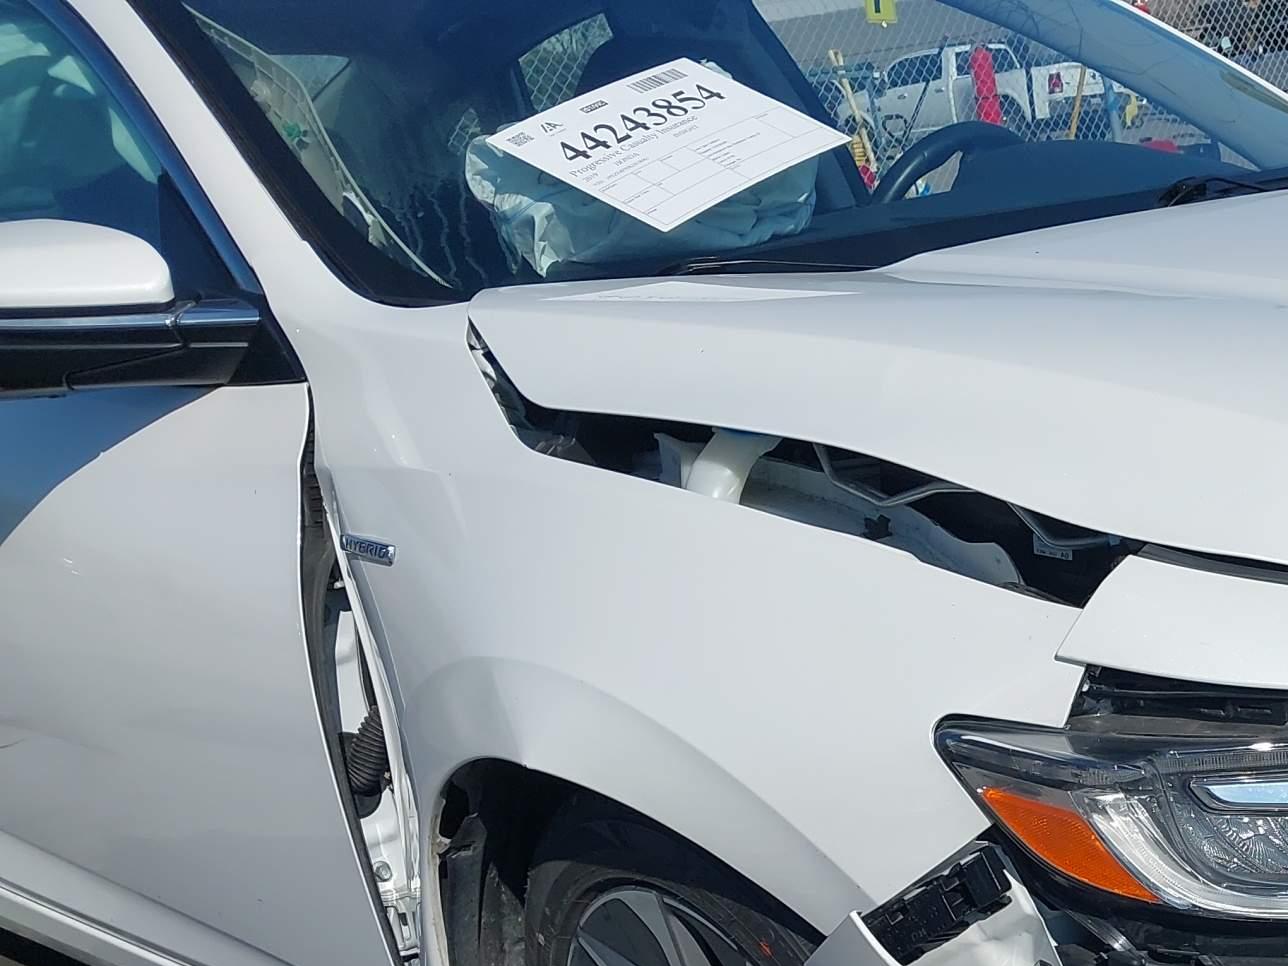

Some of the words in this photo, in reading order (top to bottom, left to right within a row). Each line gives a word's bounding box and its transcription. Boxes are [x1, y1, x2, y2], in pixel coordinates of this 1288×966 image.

[560, 83, 727, 161] 44243854
[569, 149, 622, 178] Progressive
[620, 131, 660, 152] Casualty
[656, 115, 699, 136] Insurance
[345, 537, 386, 559] HYBRID
